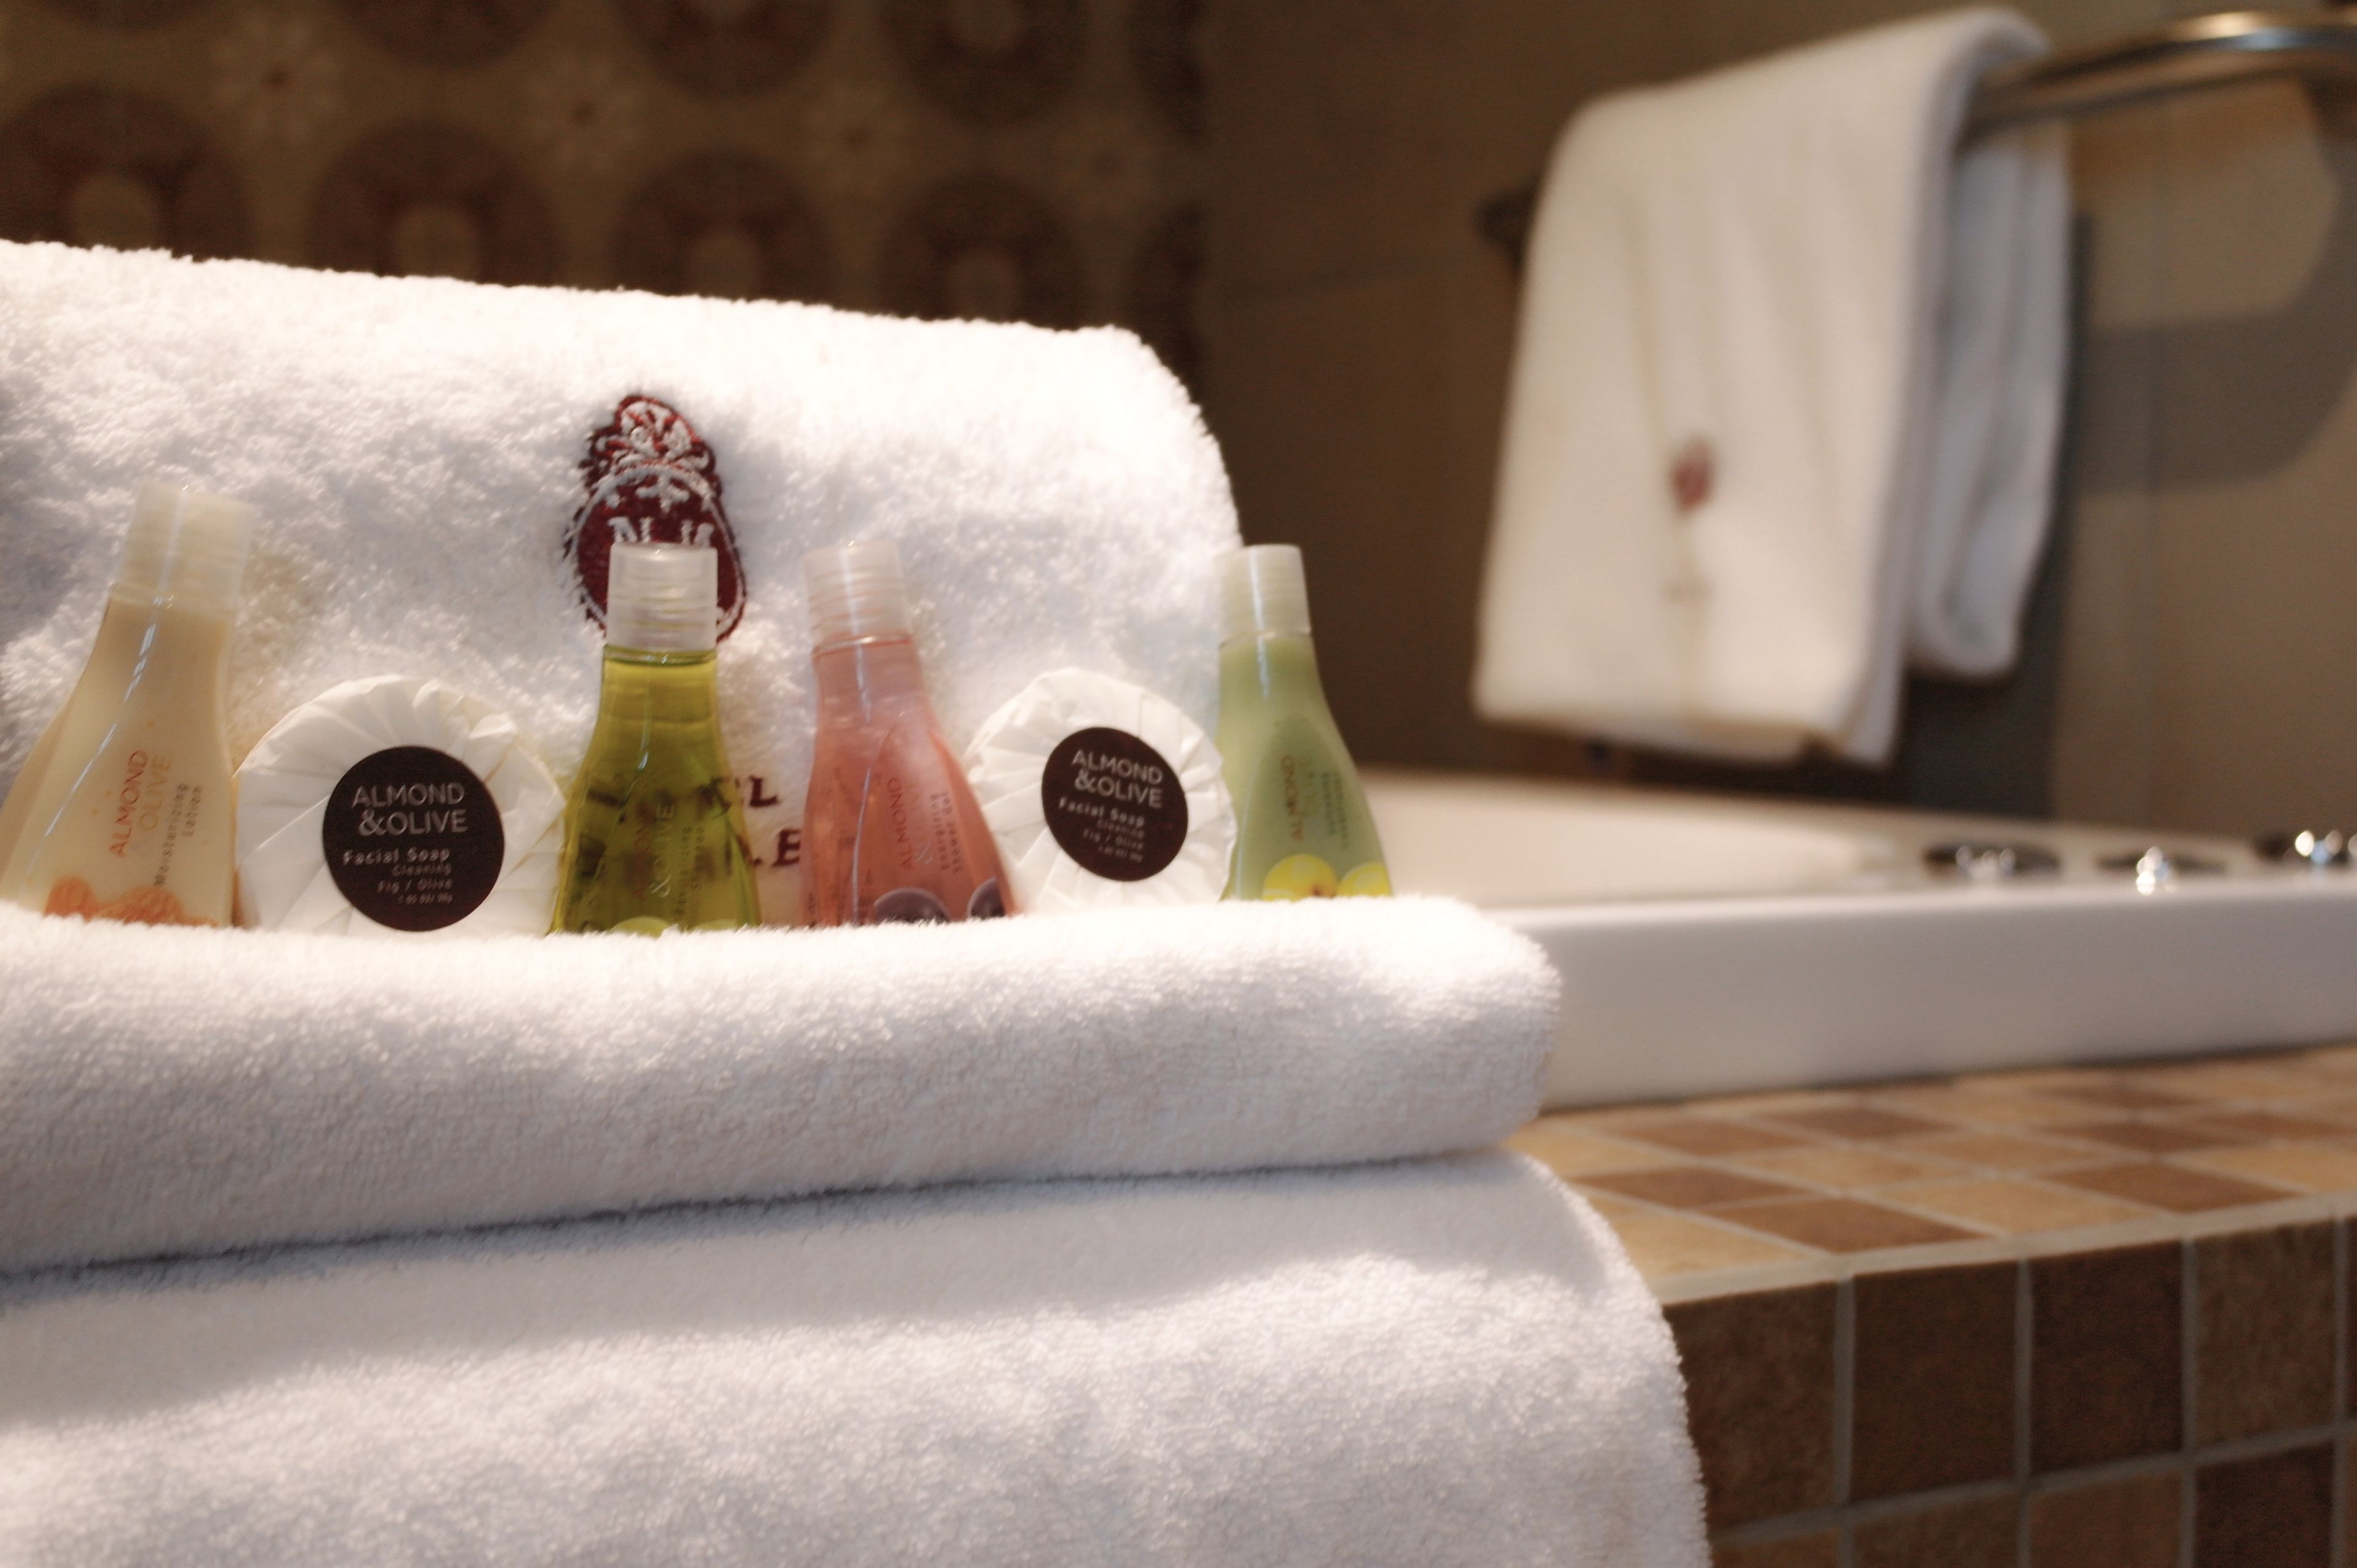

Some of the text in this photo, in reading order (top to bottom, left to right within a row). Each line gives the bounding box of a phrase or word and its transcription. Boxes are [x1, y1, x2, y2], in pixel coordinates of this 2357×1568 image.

[1072, 749, 1163, 785] ALMOND
[108, 750, 148, 858] ALMOND
[352, 782, 465, 808] ALMOND
[1075, 769, 1163, 808] &OLIVE
[358, 808, 468, 836] &OLIVE
[888, 778, 914, 870] ALMOND
[1110, 808, 1145, 827] Soap
[343, 846, 450, 865] Facial Soap
